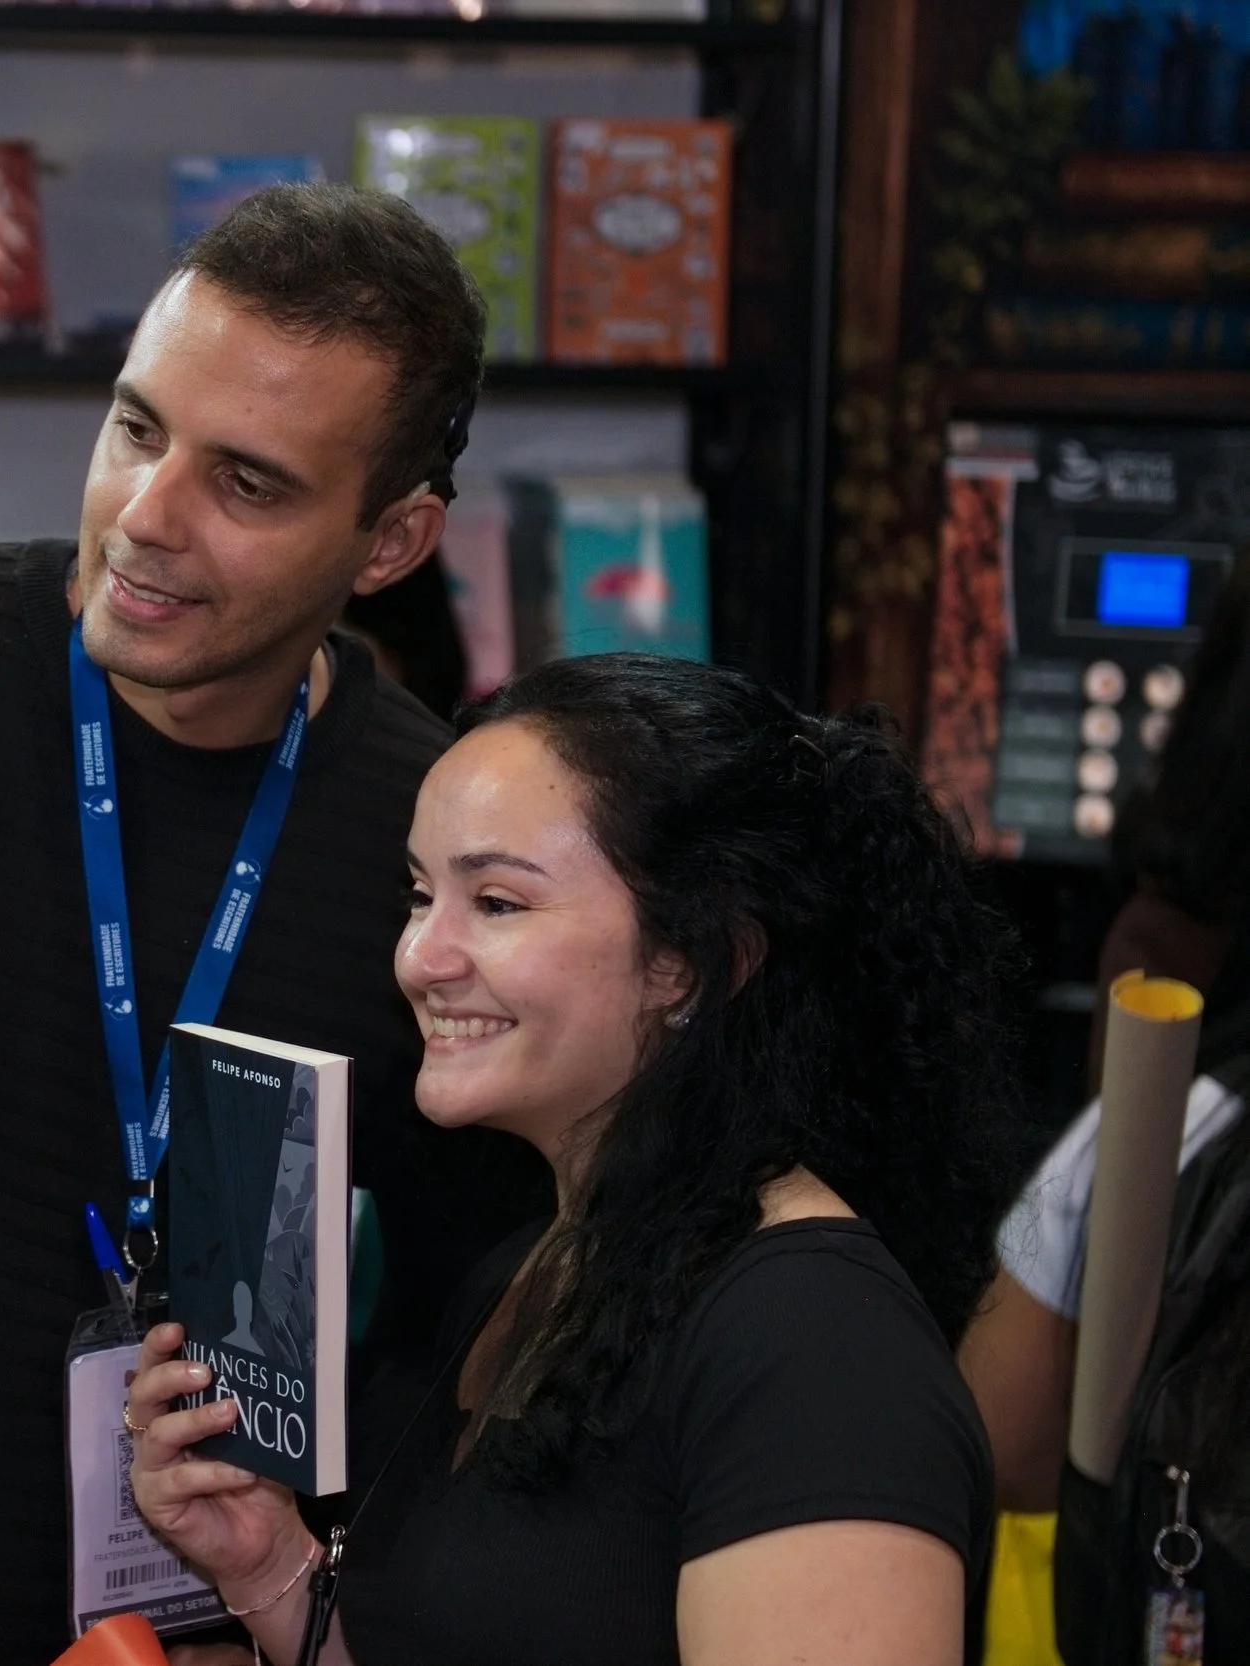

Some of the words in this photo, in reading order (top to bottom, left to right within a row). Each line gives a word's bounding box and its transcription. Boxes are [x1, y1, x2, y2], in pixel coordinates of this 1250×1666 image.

[81, 723, 96, 787] FRATERNIDADE
[92, 721, 105, 773] ESCRITORES
[96, 774, 106, 785] DE
[231, 888, 242, 900] DE
[110, 921, 124, 973] ESCRITORES
[212, 900, 237, 949] ESCRITORES
[222, 892, 252, 953] FRATERNIDADE
[100, 923, 116, 987] FRATERNIDADE
[115, 974, 125, 986] DE
[212, 1059, 240, 1077] FELIPE
[243, 1068, 281, 1088] AFONSO
[134, 1122, 147, 1173] ESCRITORES
[181, 1340, 269, 1390] NUANCES
[276, 1371, 305, 1403] DO
[108, 1529, 145, 1545] FELIPE
[168, 1603, 183, 1615] DO
